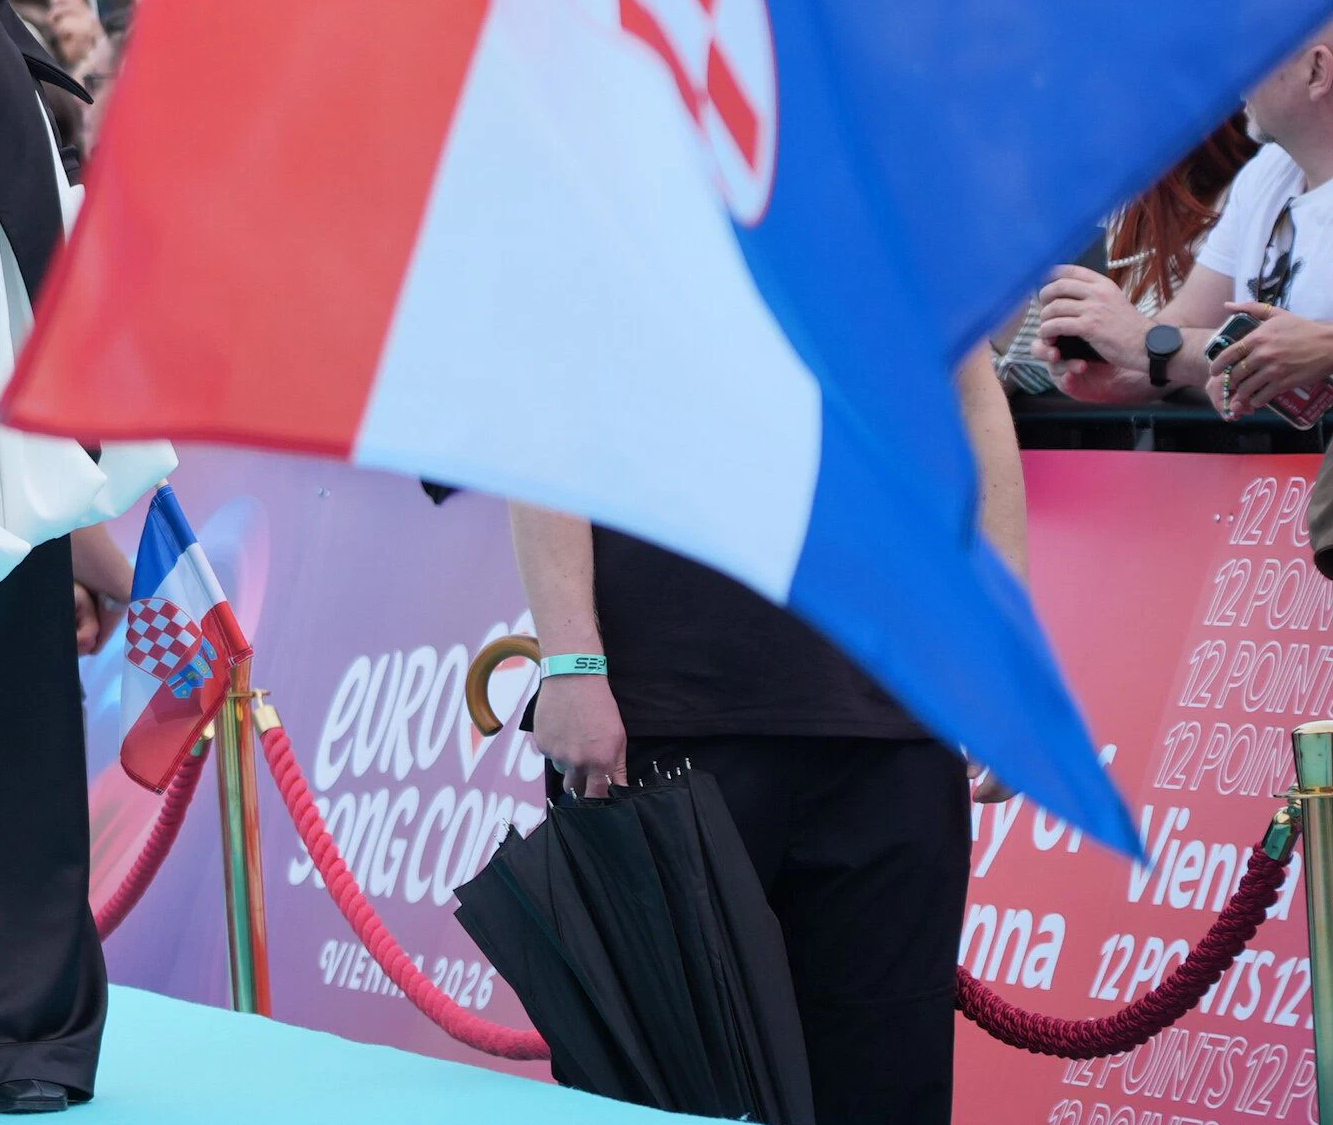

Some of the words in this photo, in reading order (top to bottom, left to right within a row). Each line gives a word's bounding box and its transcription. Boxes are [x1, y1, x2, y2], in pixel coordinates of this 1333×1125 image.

[1229, 477, 1278, 546] 12
[1203, 558, 1252, 626] 12
[1177, 640, 1227, 708] 12
[1214, 640, 1333, 719] POINT
[1153, 721, 1202, 790] 12
[433, 956, 497, 1011] 2026
[1088, 933, 1135, 1001] 12
[1124, 936, 1276, 1021] POTS
[1263, 956, 1311, 1027] 12
[1095, 1027, 1248, 1109] POINTS
[1235, 1043, 1288, 1116] 12
[1275, 1048, 1319, 1124] P
